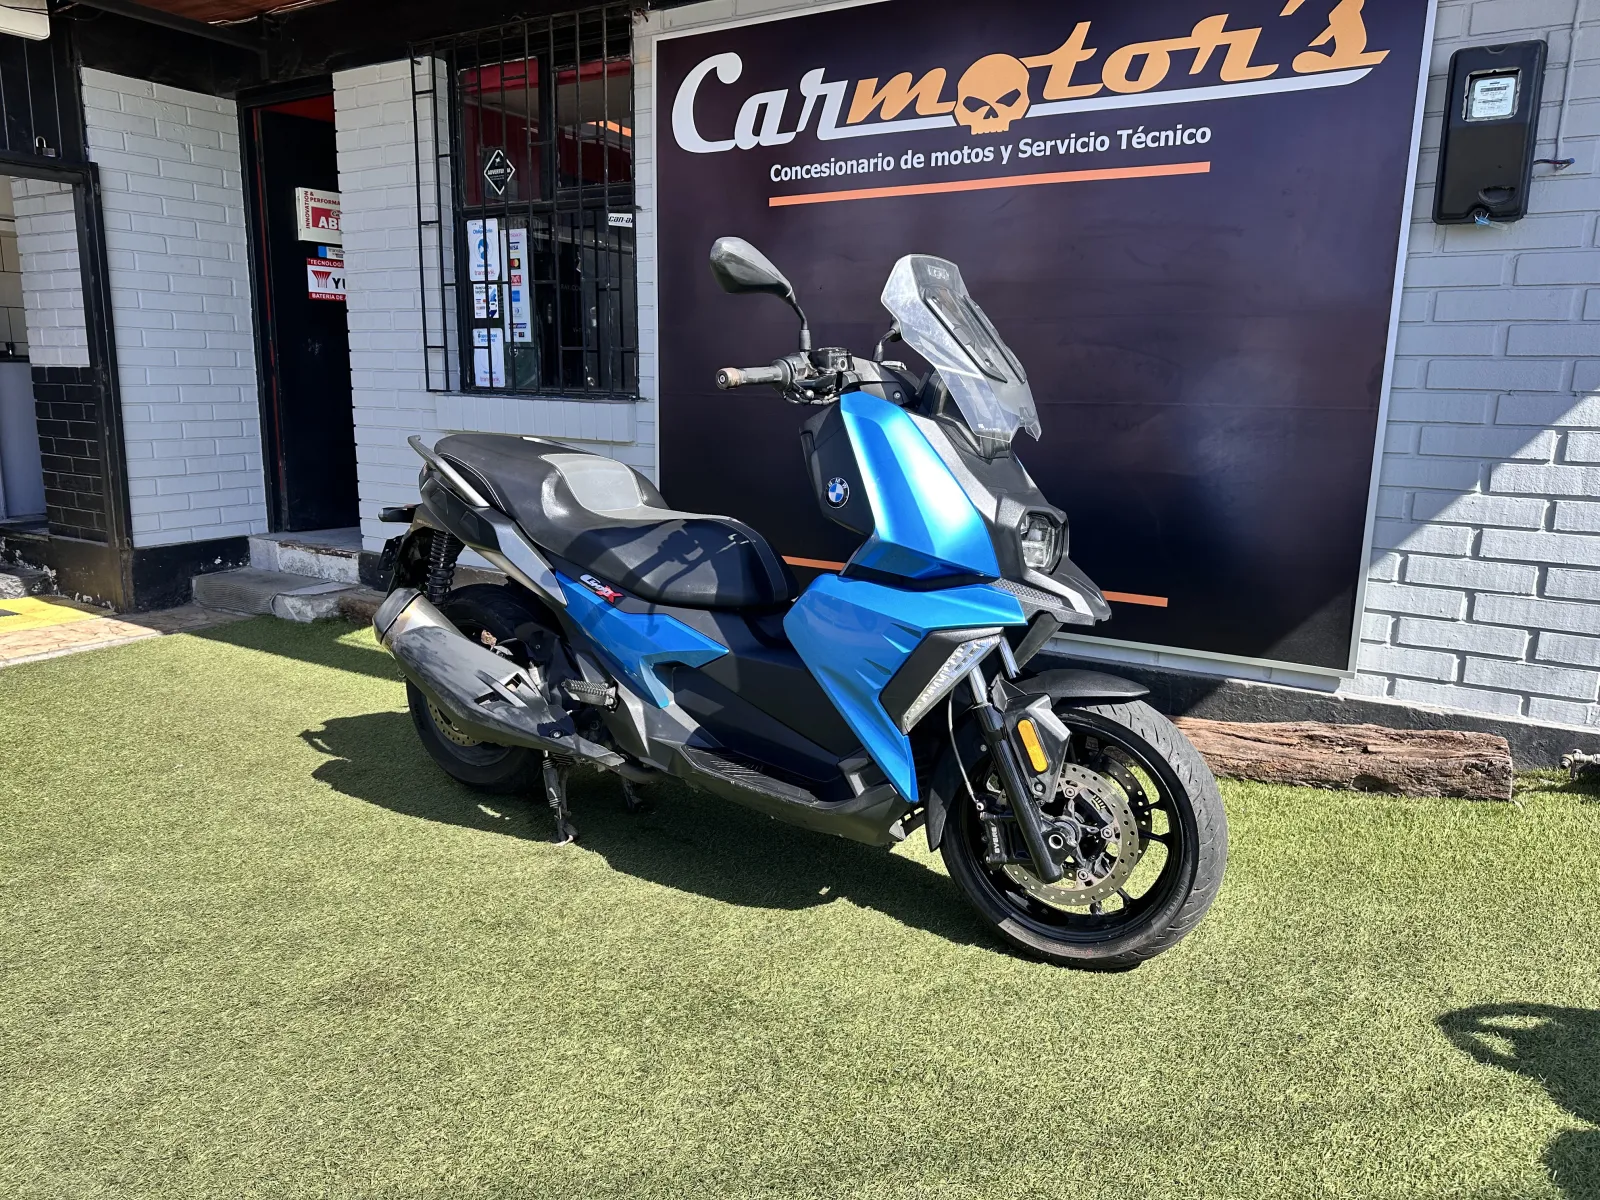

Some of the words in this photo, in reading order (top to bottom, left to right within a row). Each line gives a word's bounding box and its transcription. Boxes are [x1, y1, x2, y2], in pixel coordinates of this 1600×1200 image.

[769, 152, 895, 182] Concesionario
[900, 149, 925, 170] de
[930, 145, 995, 167] motos
[999, 143, 1013, 165] y
[1018, 131, 1110, 158] Servicio
[1117, 123, 1212, 150] Técnico
